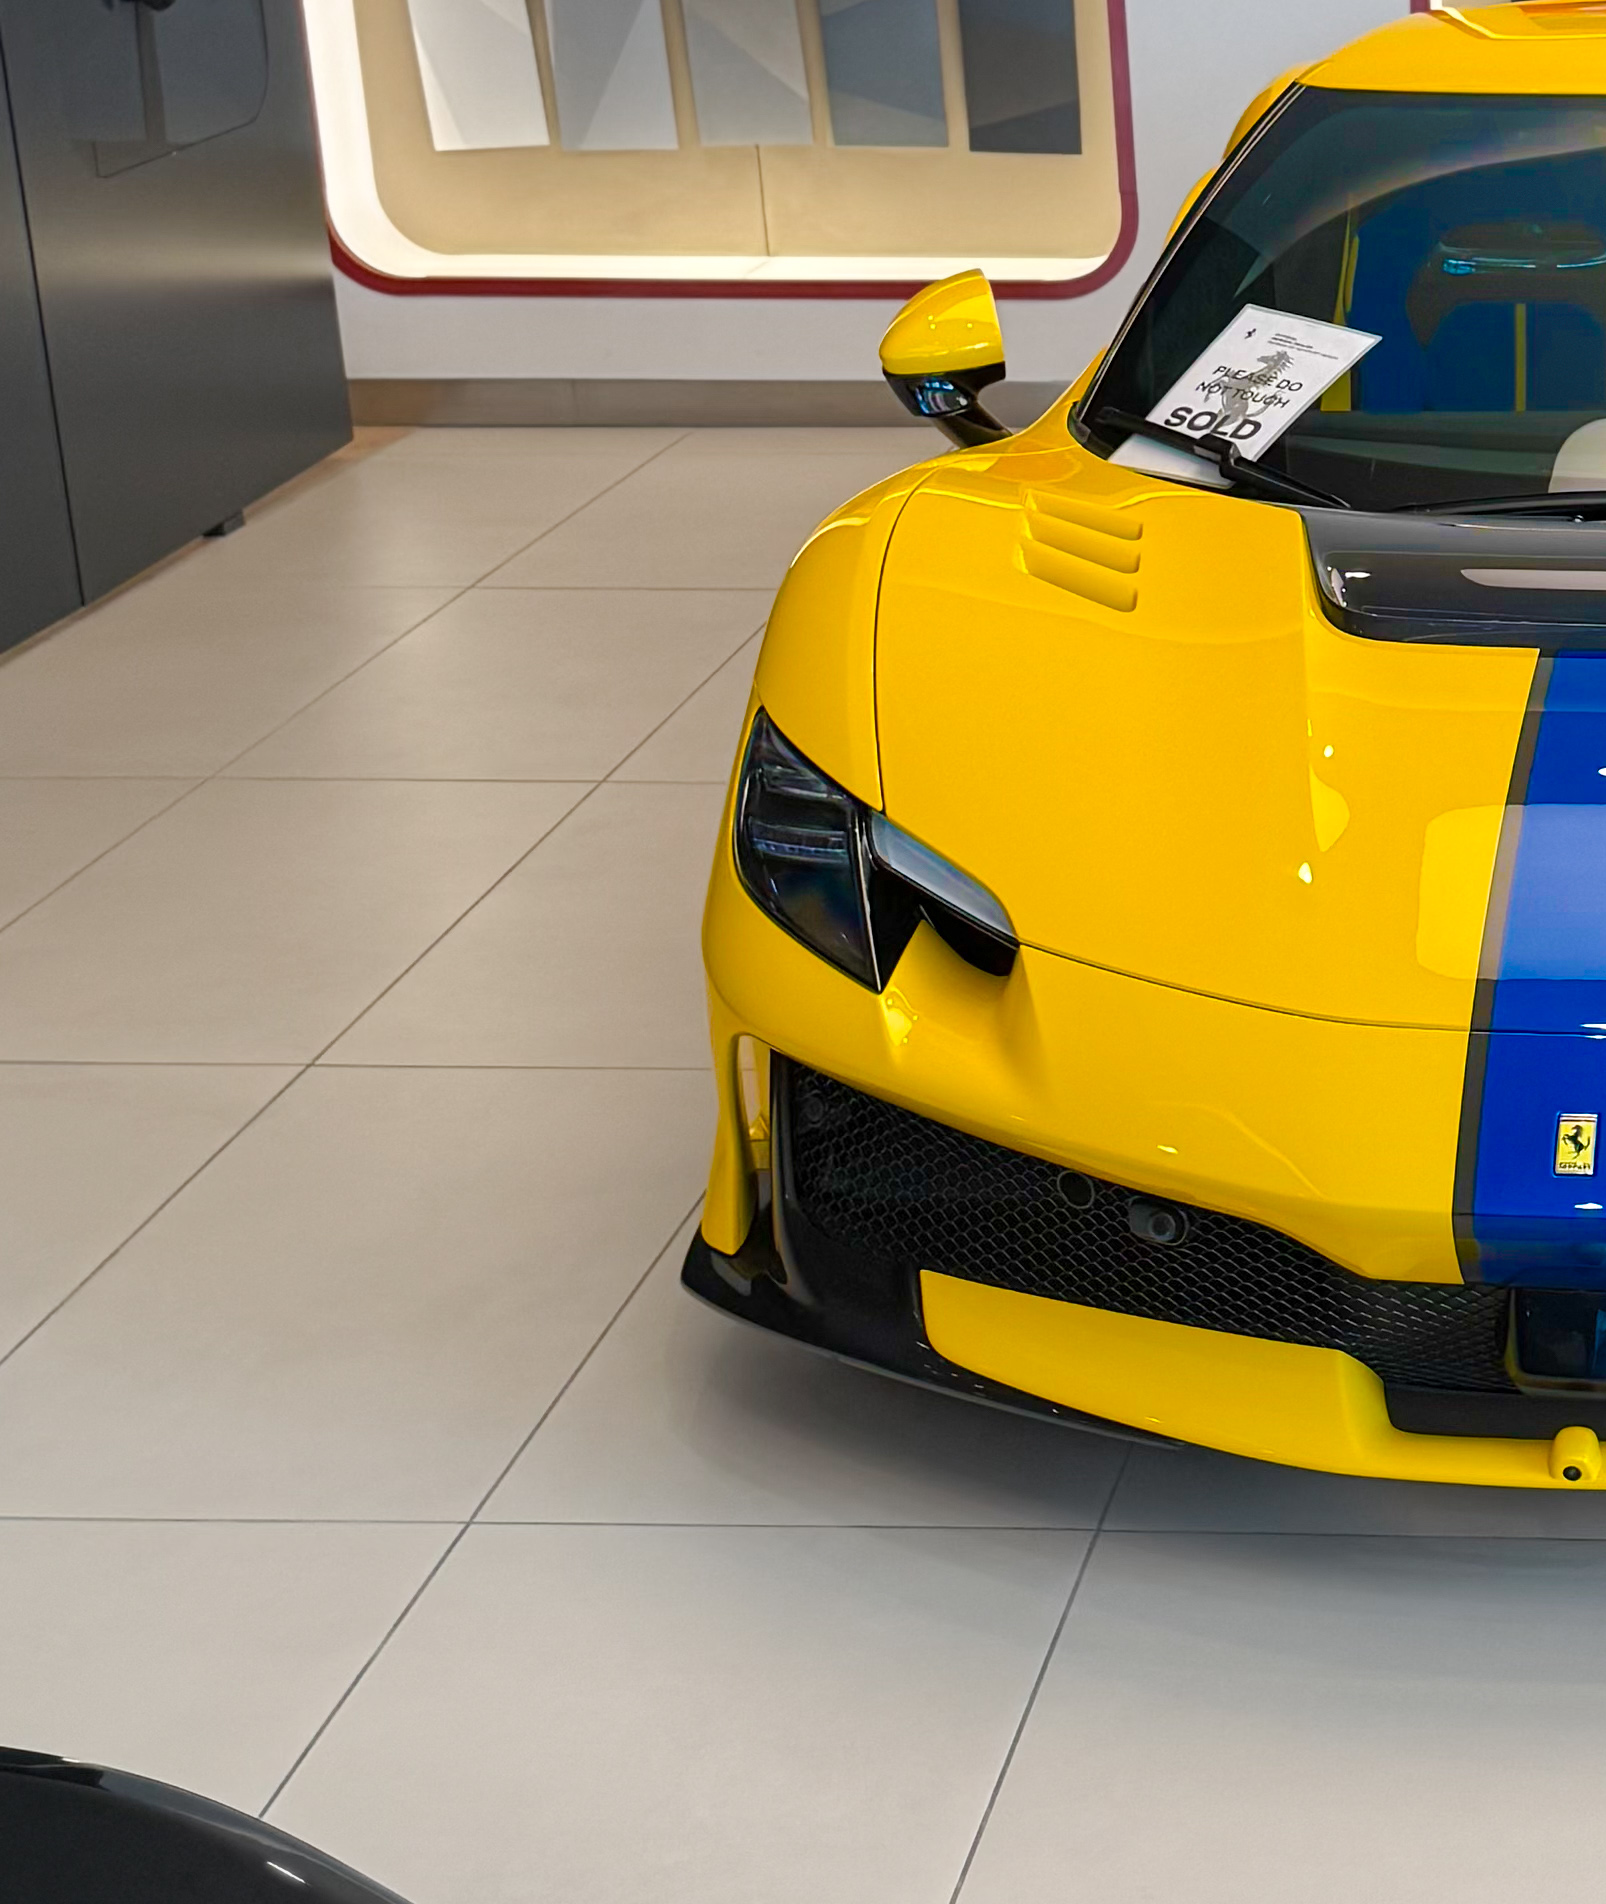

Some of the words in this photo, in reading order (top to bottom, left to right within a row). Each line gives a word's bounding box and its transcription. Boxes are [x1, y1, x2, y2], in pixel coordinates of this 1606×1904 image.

[1212, 365, 1278, 386] PLEASE
[1276, 378, 1303, 391] DO
[1195, 381, 1232, 395] NOT
[1232, 388, 1291, 408] TOUCH
[1164, 406, 1262, 440] SOLD
